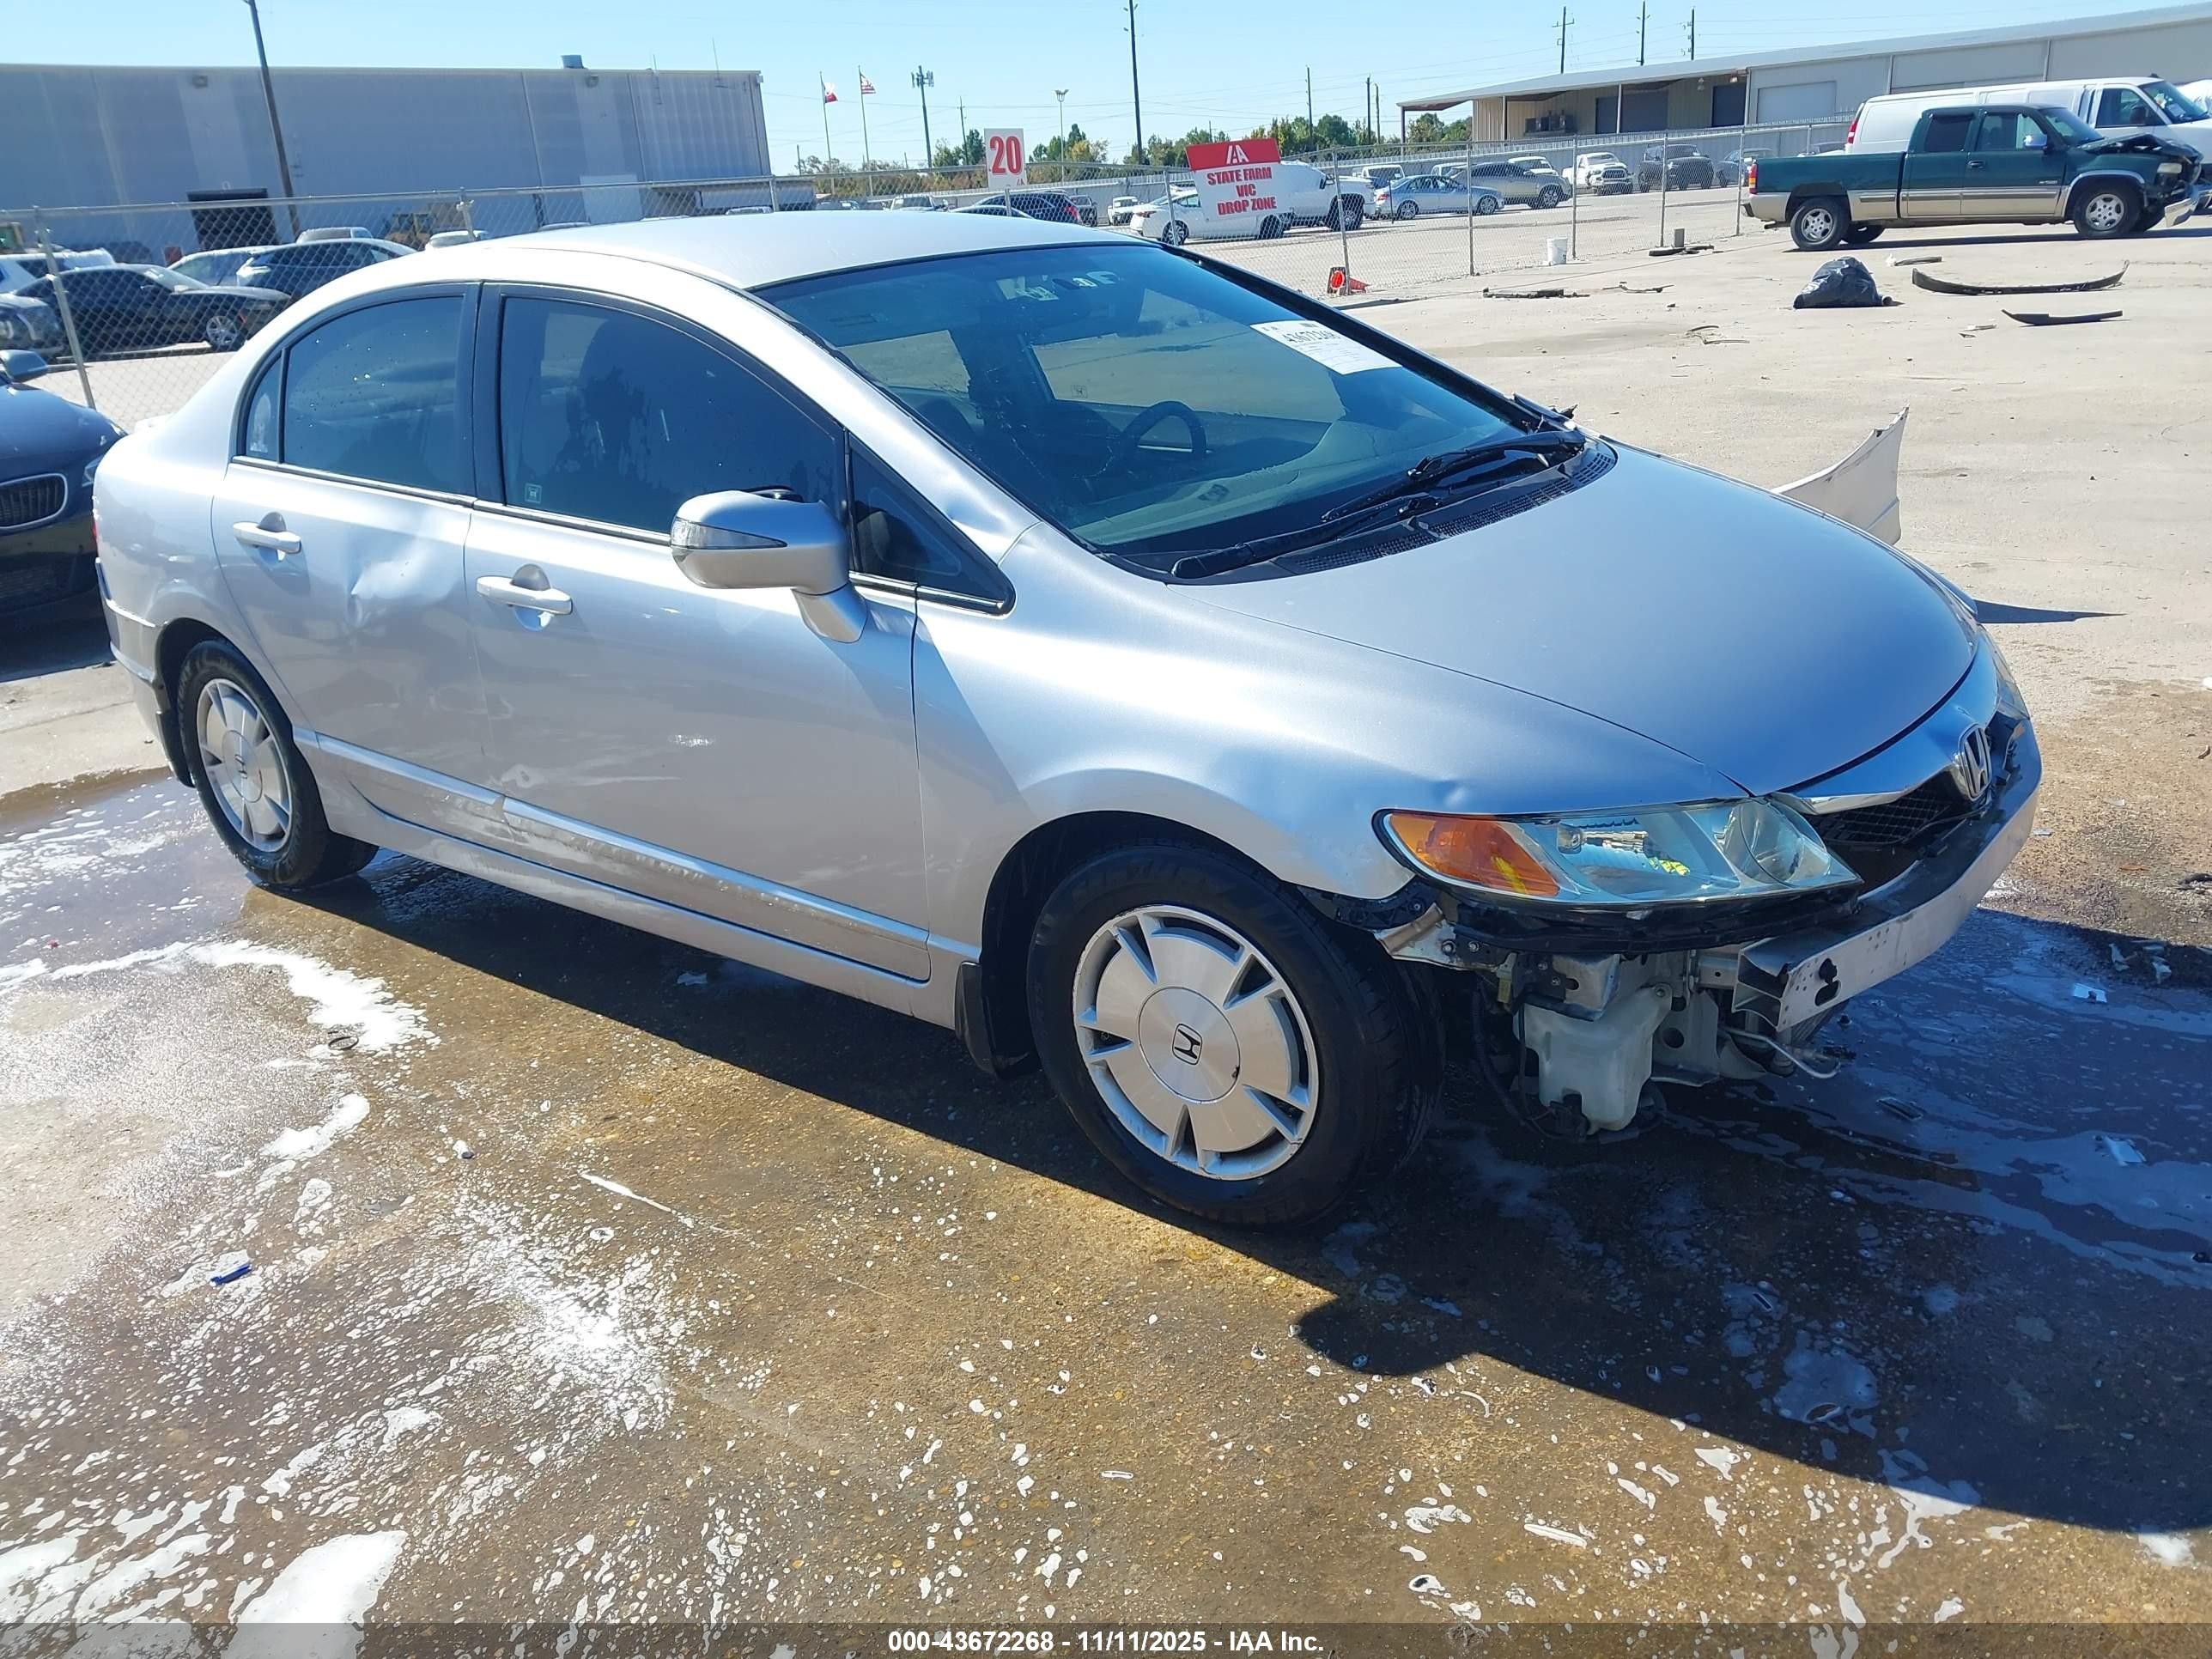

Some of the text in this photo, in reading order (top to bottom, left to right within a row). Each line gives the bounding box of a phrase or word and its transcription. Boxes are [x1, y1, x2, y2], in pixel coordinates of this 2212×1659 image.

[989, 136, 1022, 174] 20
[1206, 167, 1273, 185] STATE FARM
[1236, 183, 1256, 198] VIC
[1217, 197, 1277, 216] DROP ZONE
